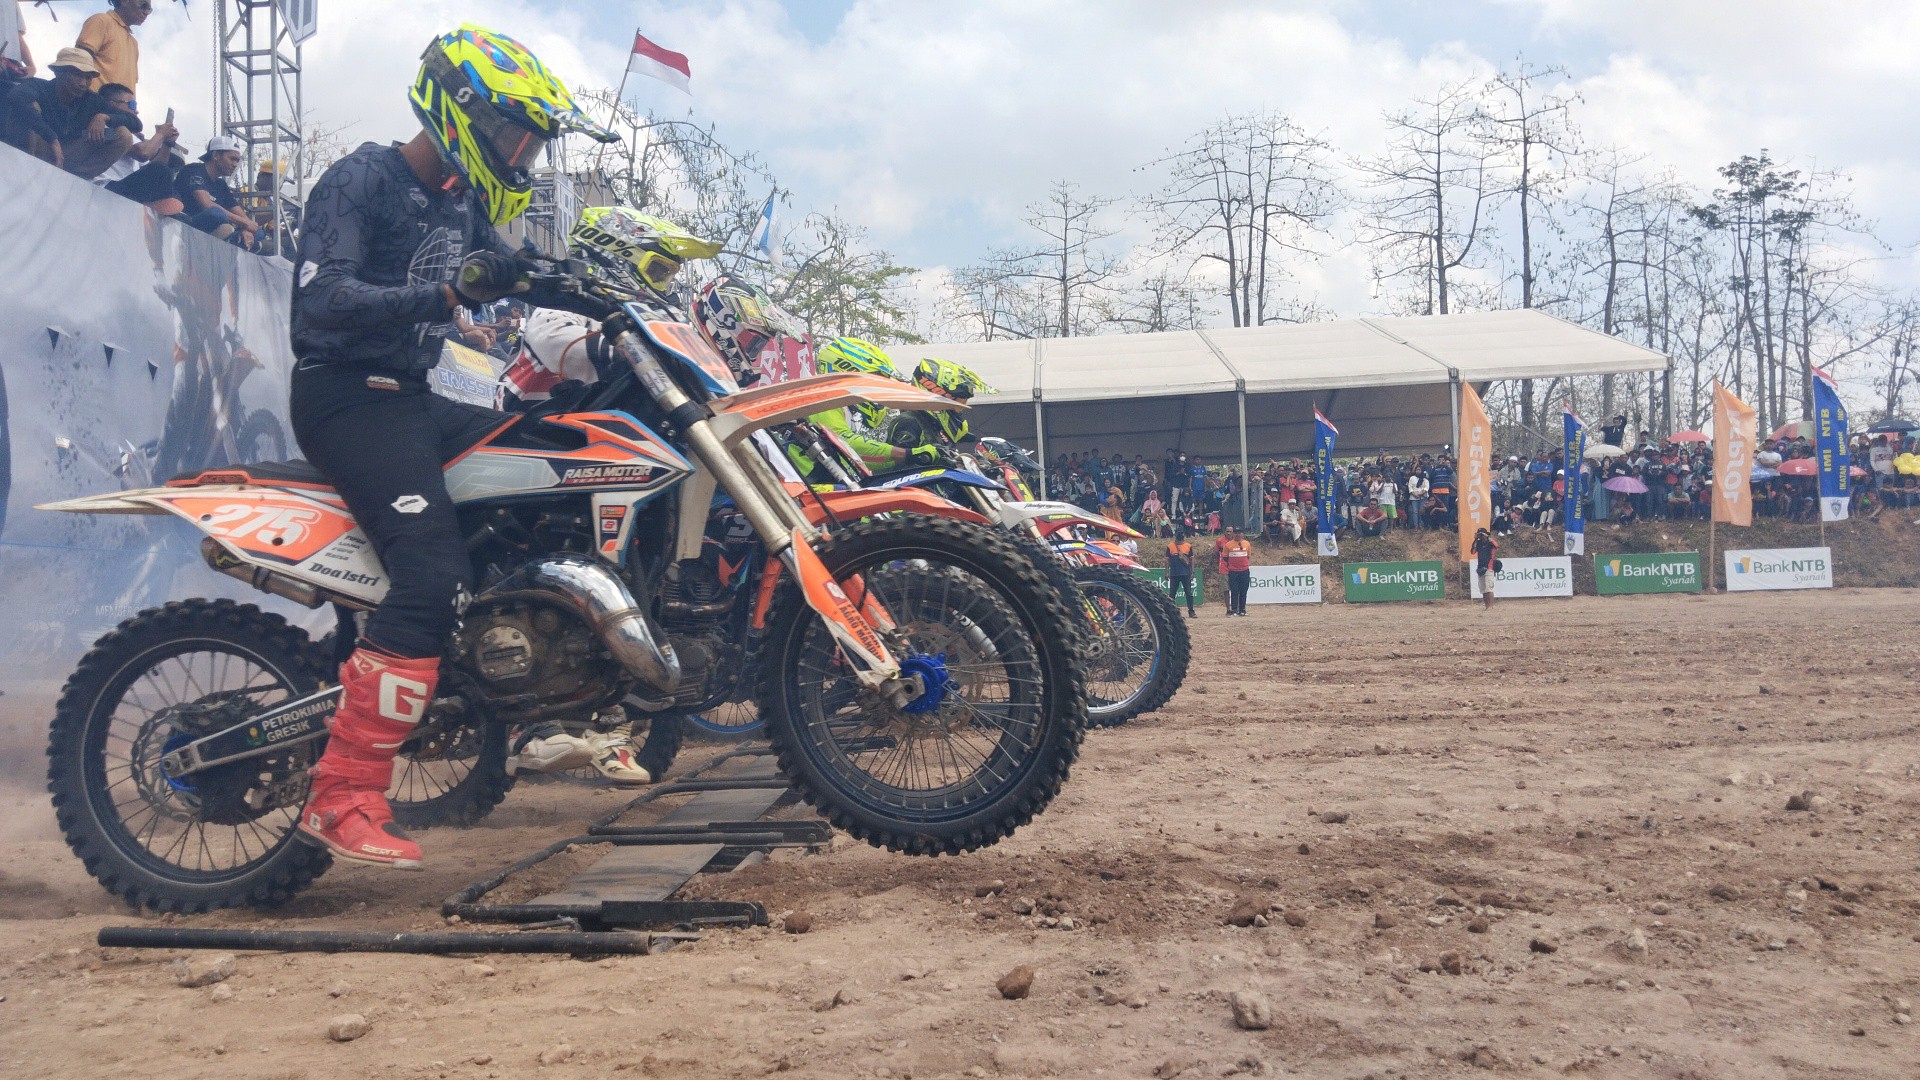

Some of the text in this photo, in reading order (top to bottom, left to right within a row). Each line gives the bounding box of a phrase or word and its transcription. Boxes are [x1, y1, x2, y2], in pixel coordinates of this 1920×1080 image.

[572, 224, 633, 258] 100%
[1821, 408, 1832, 472] IMI NTB
[1837, 431, 1847, 456] MOTOR
[562, 465, 653, 484] RAISA MOTOR
[1839, 465, 1847, 490] IKATAN
[206, 503, 317, 547] 275
[1406, 582, 1439, 594] Syariah
[1534, 580, 1567, 591] Syariah
[1661, 576, 1696, 587] Syariah
[1792, 573, 1826, 583] Syariah
[1284, 588, 1315, 598] Syariah
[261, 699, 336, 731] PETROKIMIA
[266, 720, 311, 742] GRESIK
